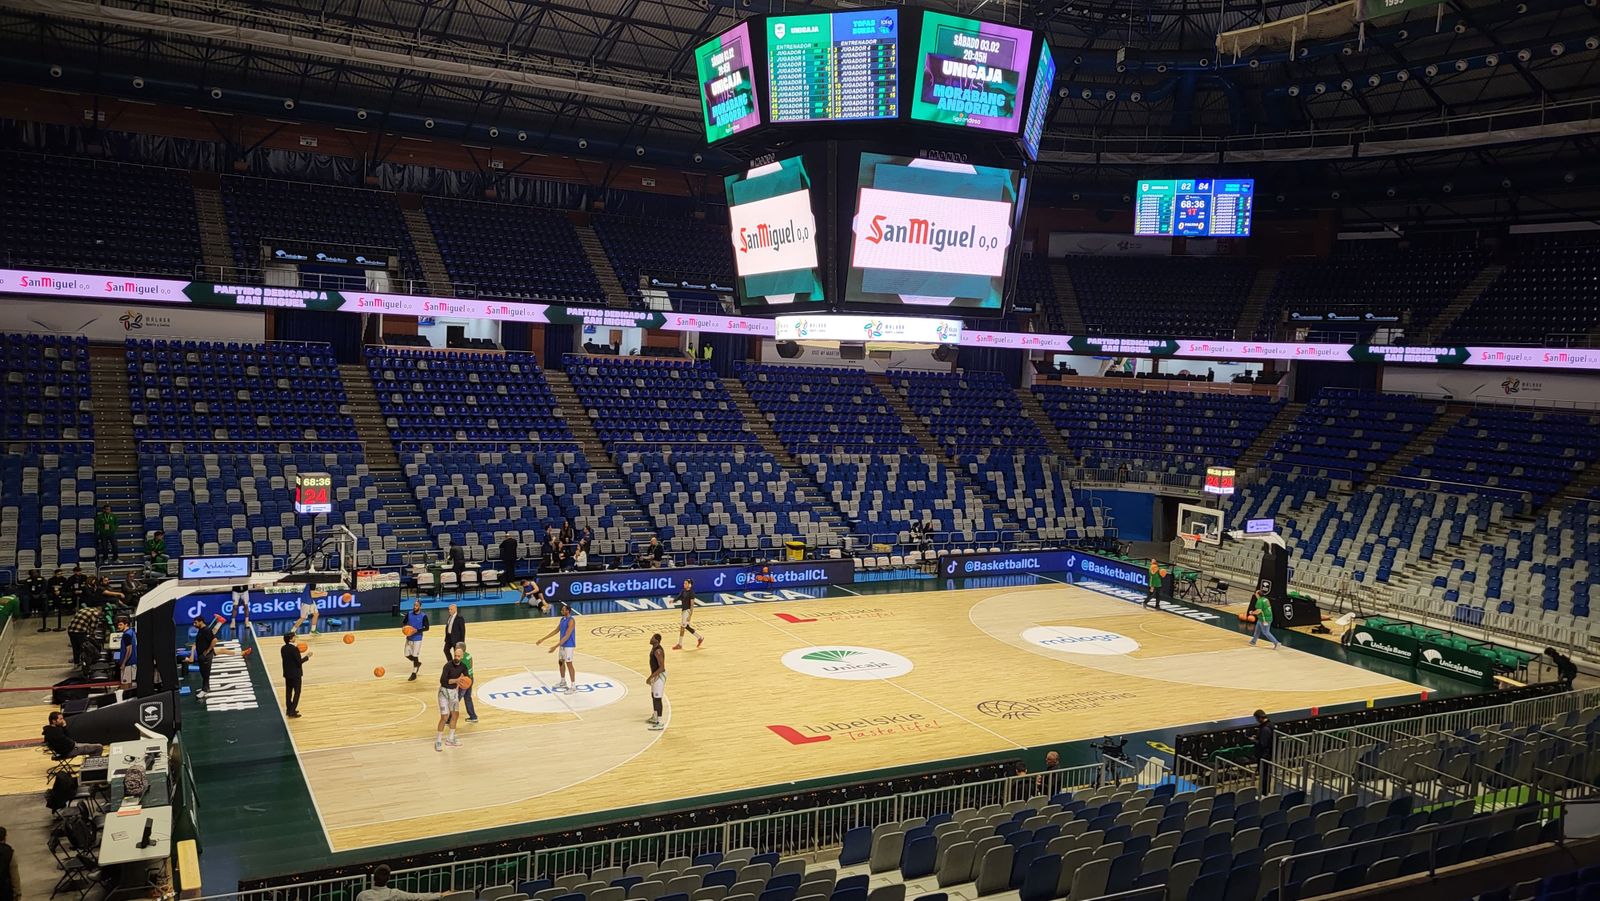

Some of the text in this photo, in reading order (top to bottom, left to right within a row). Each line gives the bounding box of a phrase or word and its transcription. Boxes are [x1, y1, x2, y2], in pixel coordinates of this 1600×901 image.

[954, 34, 1000, 53] SÁBADO 03.02
[963, 49, 988, 63] 20:45H
[942, 60, 1002, 83] UNICAJA
[710, 70, 742, 96] UNICAJA
[933, 84, 1005, 106] MORABANC
[937, 98, 998, 117] ANDORRA
[797, 226, 808, 243] 0,0
[979, 237, 998, 251] 0,0
[214, 285, 328, 300] PARTIDO DEDICADO A
[236, 295, 306, 308] SAN MIGUEL
[567, 308, 603, 317] PARTIDO
[604, 310, 646, 319] DEDICADO
[583, 316, 602, 325] SAN
[1120, 339, 1160, 347] DEDICADO
[304, 478, 330, 486] 68:36
[304, 487, 327, 504] 24
[964, 558, 1040, 572] @BasketballCL
[1081, 560, 1148, 586] @BasketballCL
[570, 577, 676, 595] @BasketballCL
[1371, 642, 1412, 657] Unicaja Banco
[823, 662, 890, 672] Unicaja
[1439, 659, 1483, 676] Unicaja Banco
[839, 720, 941, 741] Taste life!
